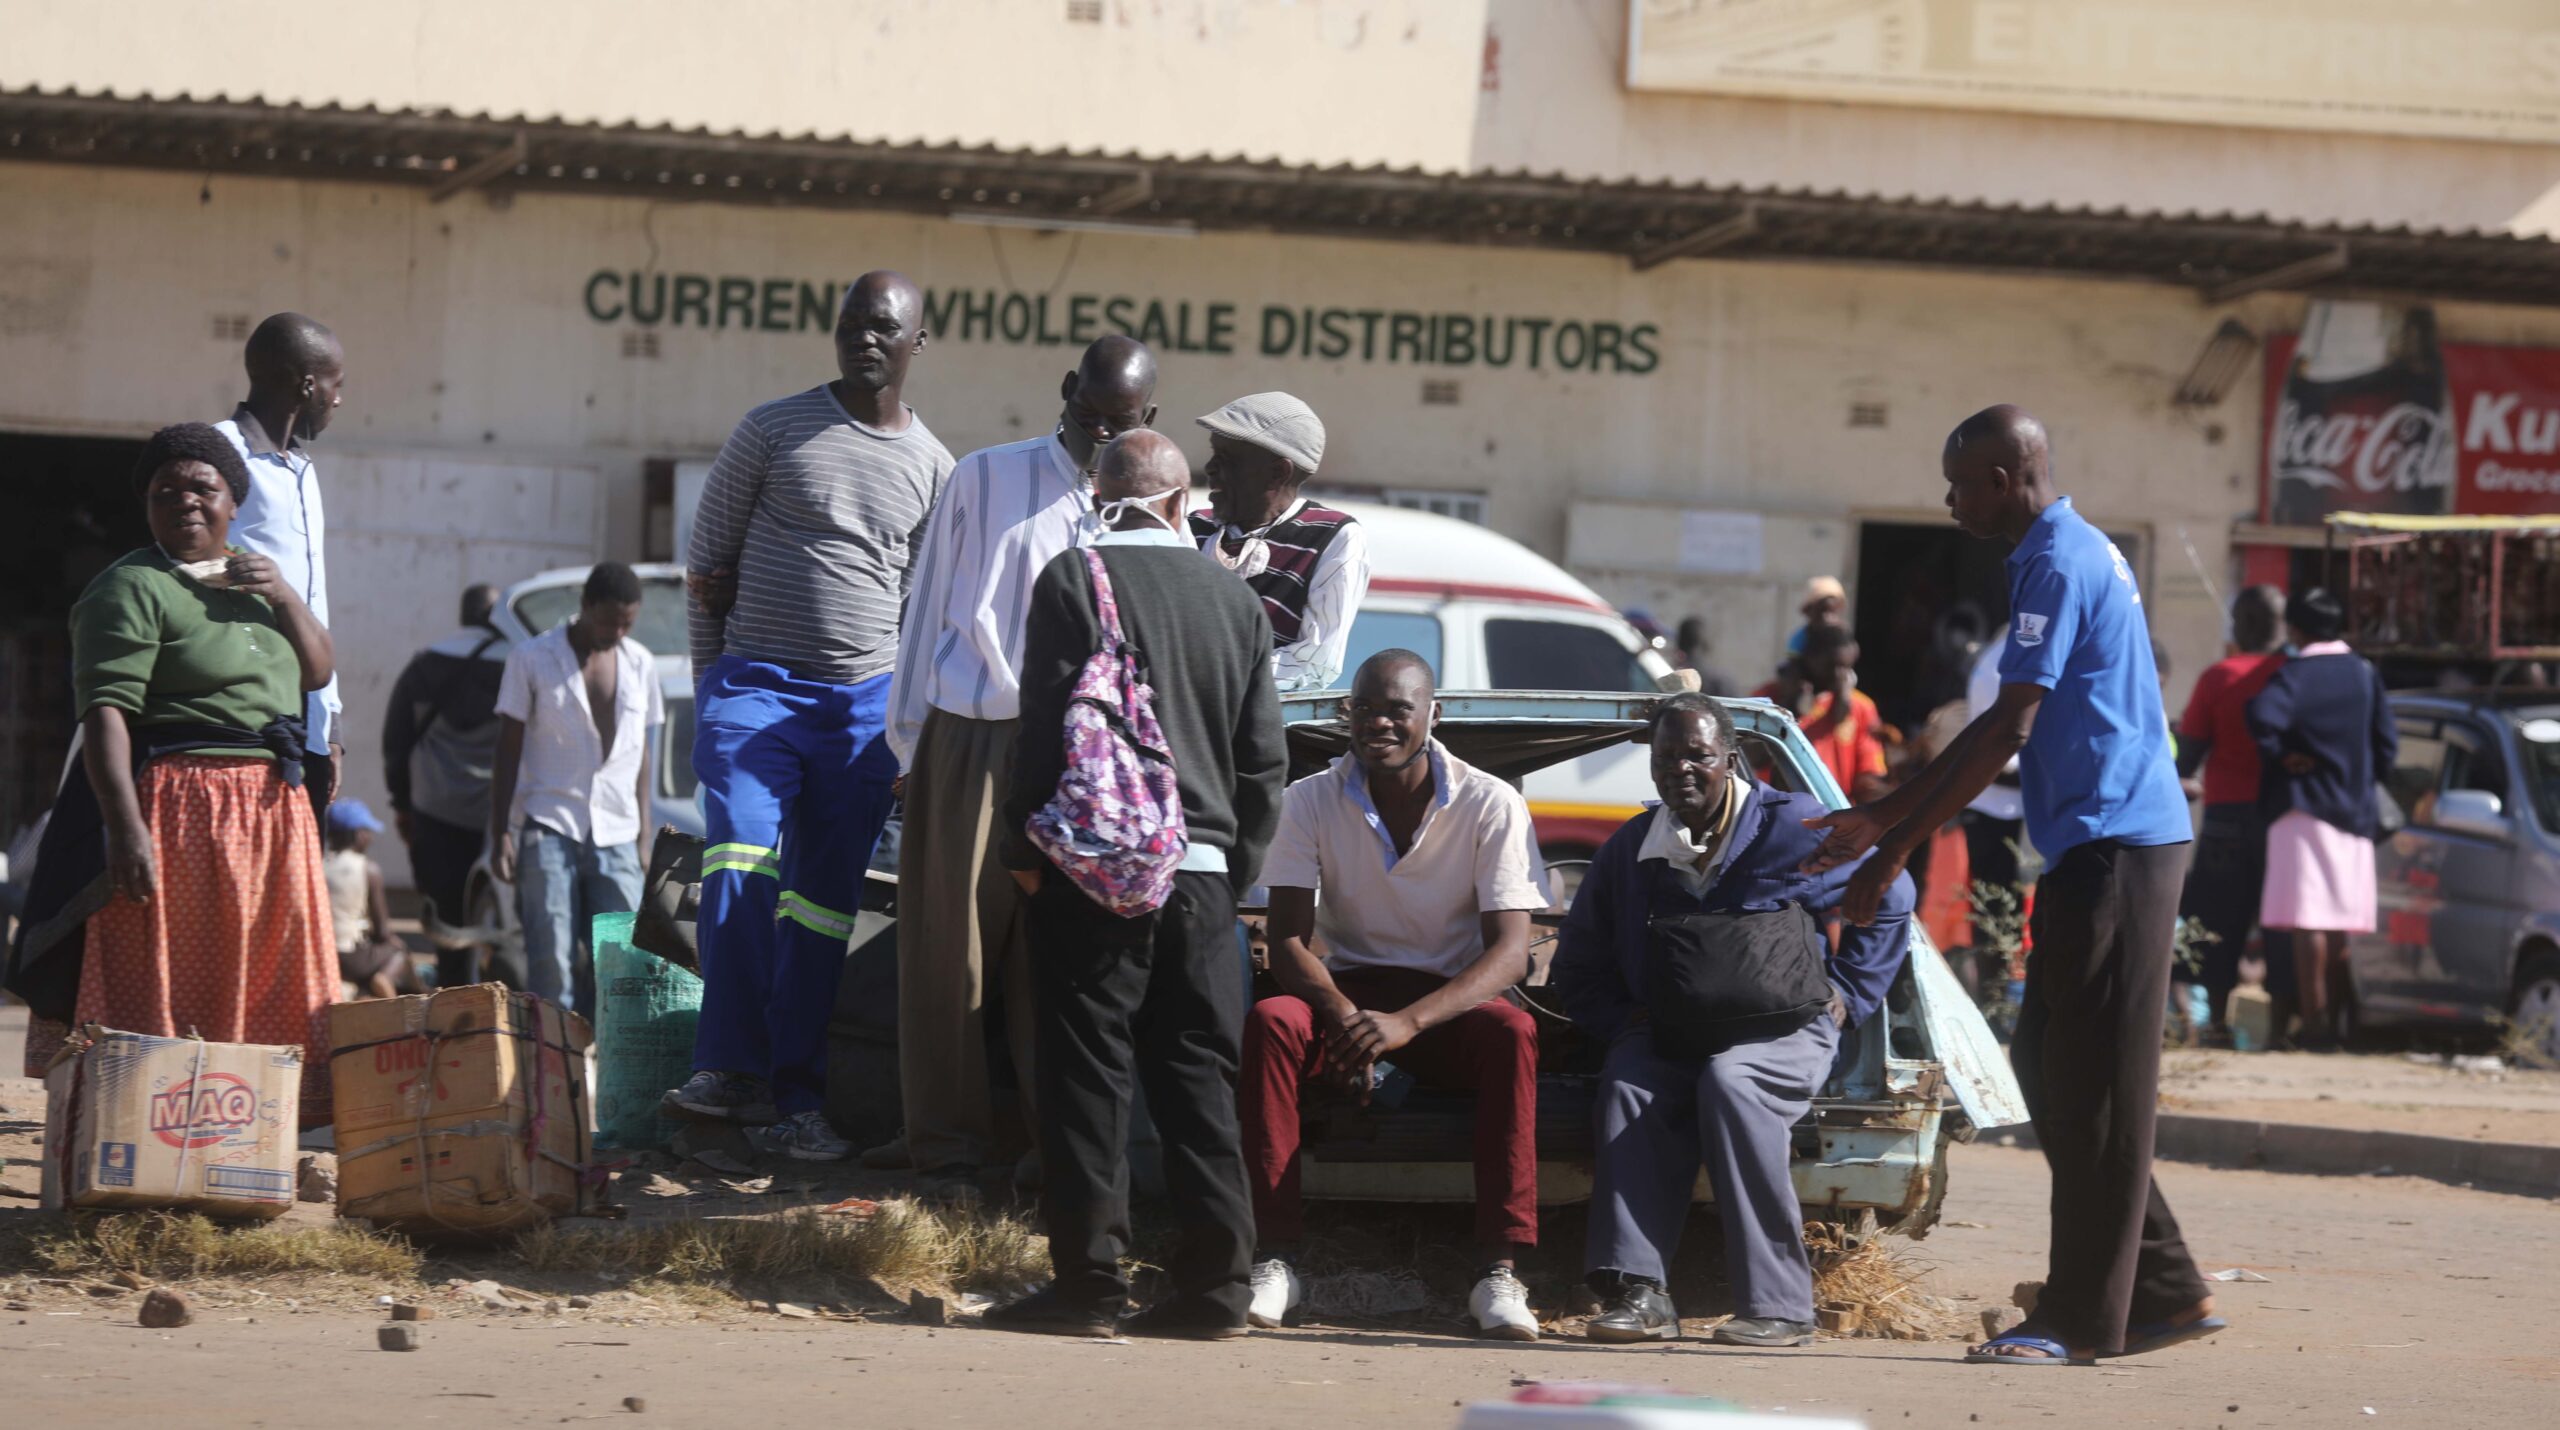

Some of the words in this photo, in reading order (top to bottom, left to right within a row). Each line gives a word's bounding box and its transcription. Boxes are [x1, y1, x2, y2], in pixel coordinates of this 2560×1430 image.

[584, 270, 851, 333] CURREN
[1259, 306, 1661, 375] DISTRIBUTORS
[151, 1085, 256, 1131] MAQ
